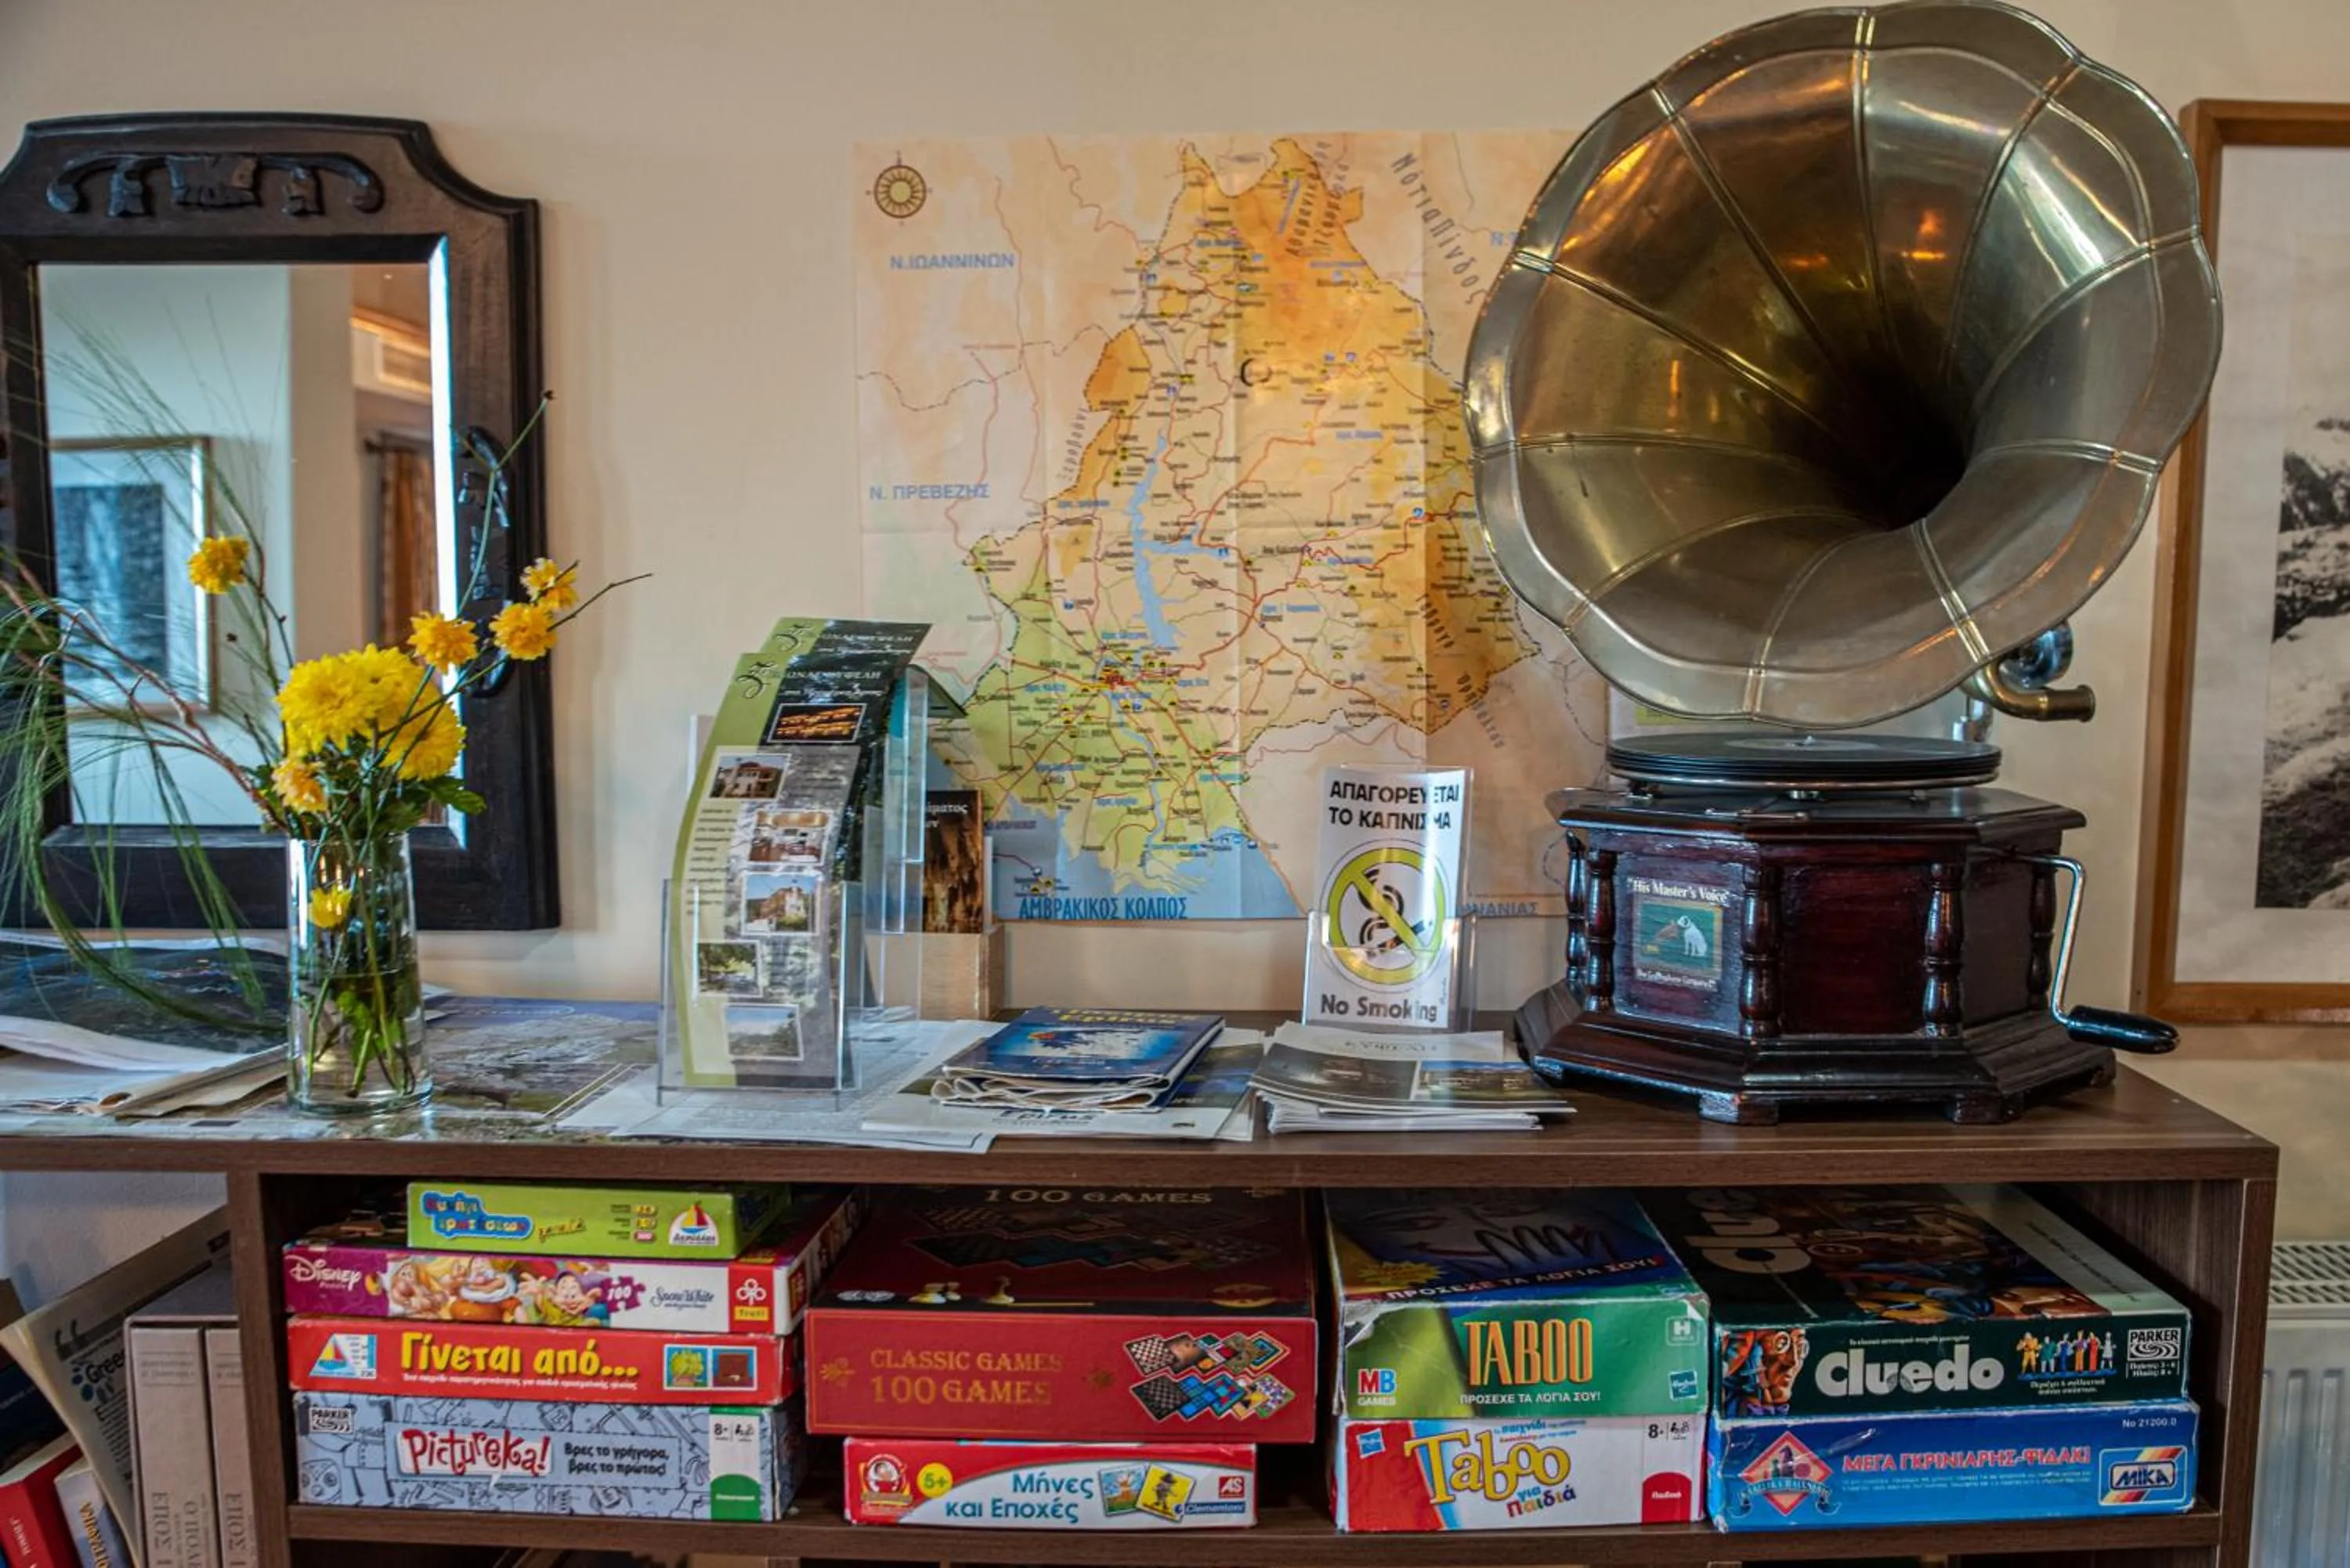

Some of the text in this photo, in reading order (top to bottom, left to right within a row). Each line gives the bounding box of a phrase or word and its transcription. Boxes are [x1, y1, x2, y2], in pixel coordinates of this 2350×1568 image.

[893, 483, 990, 500] ΠΡΕΒΕΖΗΣ
[1329, 781, 1459, 804] ΑΠΑΓΟΡΕΥΕΤΑΙ
[1329, 807, 1451, 830] ΤΟ ΚΑΠΝΙΣΜΑ
[1020, 897, 1188, 920] ΑΜΒΡΑΚΙΚΟΣ ΚΟΛΠΟΣ
[1321, 994, 1349, 1015] No
[985, 1188, 1213, 1205] 100 GAMES
[284, 1254, 362, 1291] Disney
[1386, 1280, 1491, 1300] ΠΡΟΣΕΧΕ
[1501, 1276, 1528, 1286] ΤΑ
[2130, 1331, 2178, 1343] PARKER
[400, 1331, 522, 1375] Γίνεται
[870, 1349, 1064, 1371] CLASSIC GAMES
[1463, 1318, 1593, 1386] TABOO
[84, 1348, 125, 1384] Gree
[1814, 1343, 2005, 1397] Cluedo
[871, 1375, 1052, 1405] 100 GAMES
[1358, 1368, 1397, 1394] MB
[1358, 1396, 1397, 1407] GAMES
[1459, 1391, 1601, 1404] ΠΡΟΣΕΧΕ ΤΑ ΛΟΓΙΑ ΣΟΥ!
[402, 1428, 551, 1478] Pictureka!
[1842, 1454, 1897, 1472] ΜΕΓΑ
[1404, 1429, 1571, 1505] Taboo
[1011, 1472, 1094, 1498] Μήνες
[1516, 1485, 1542, 1502] για
[945, 1497, 1079, 1523] και Εποχές
